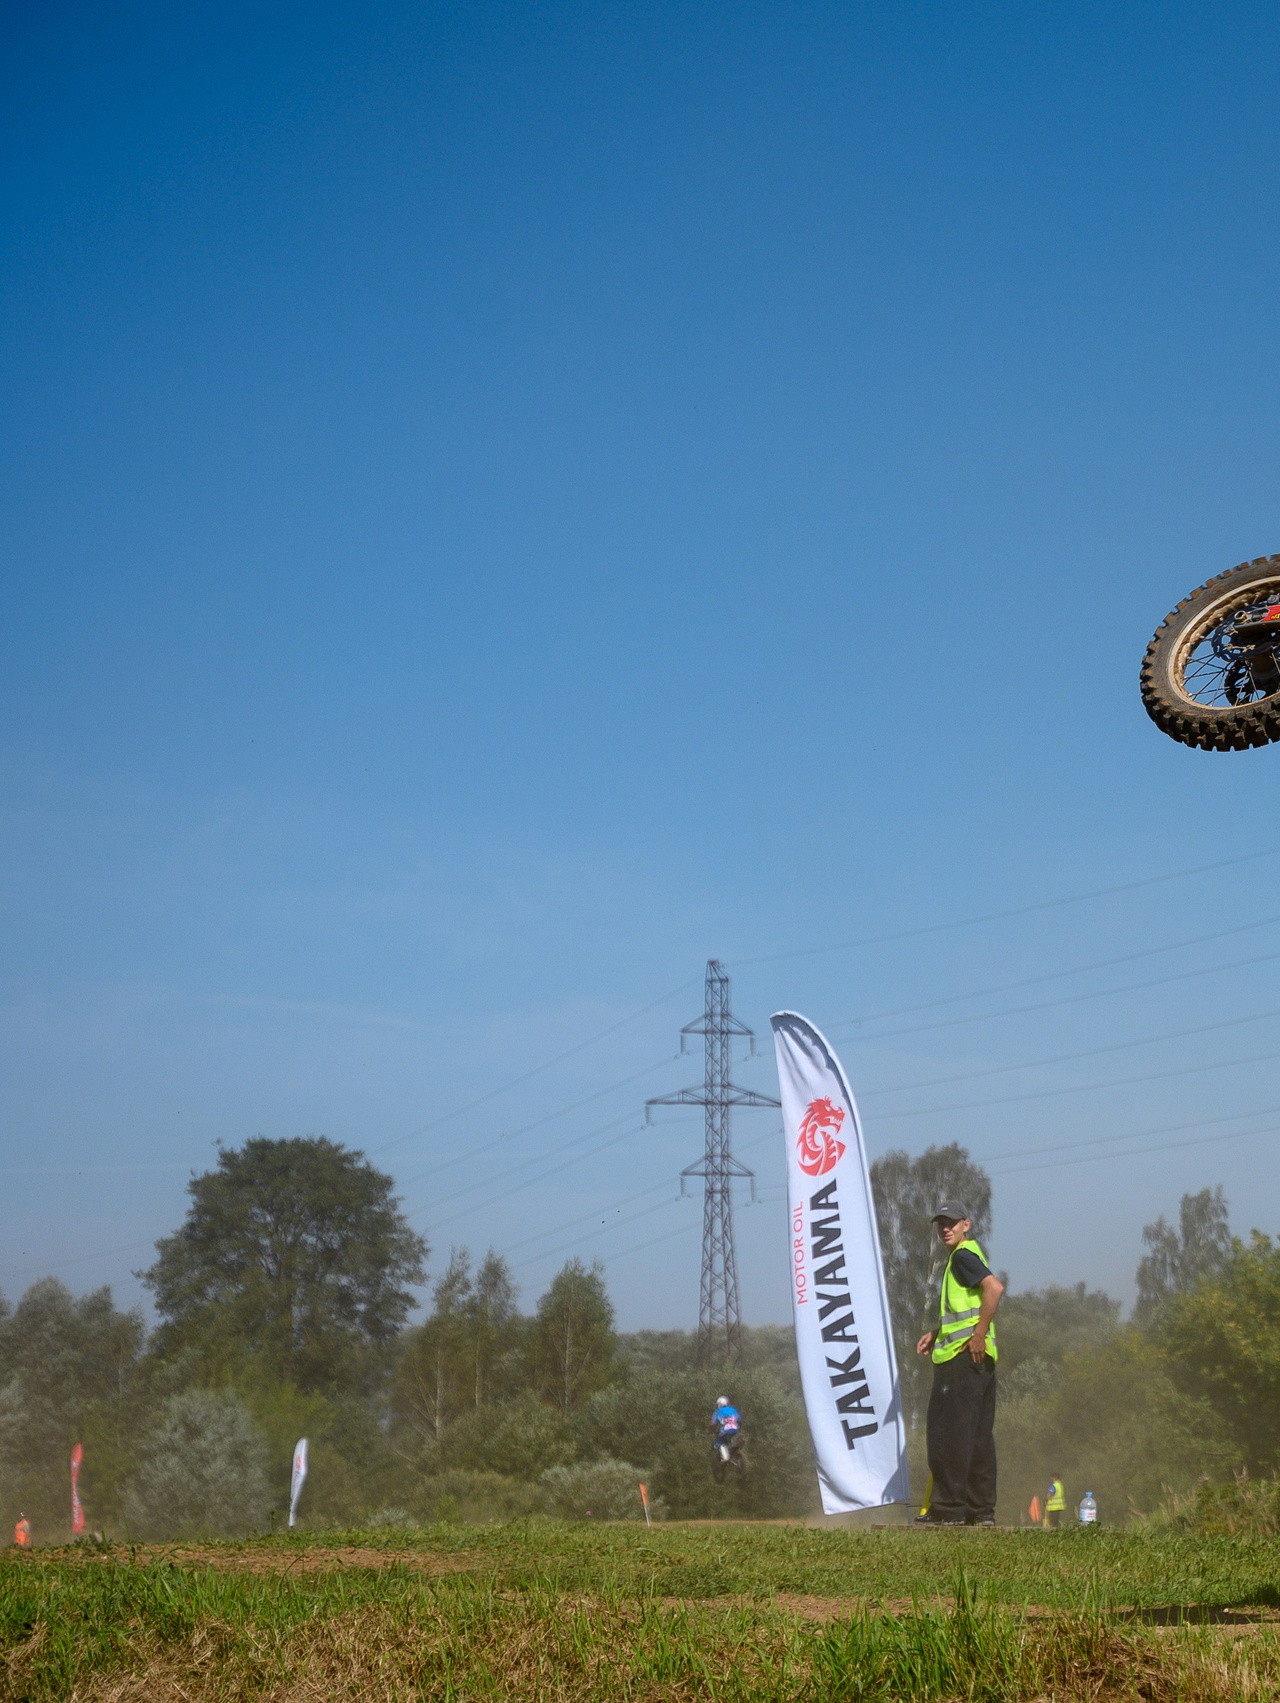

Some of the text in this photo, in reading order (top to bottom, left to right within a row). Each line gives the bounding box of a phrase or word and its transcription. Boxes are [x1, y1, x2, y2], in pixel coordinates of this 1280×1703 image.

[793, 1201, 808, 1305] MOTOR OIL
[810, 1178, 878, 1451] TAKAYAMA
